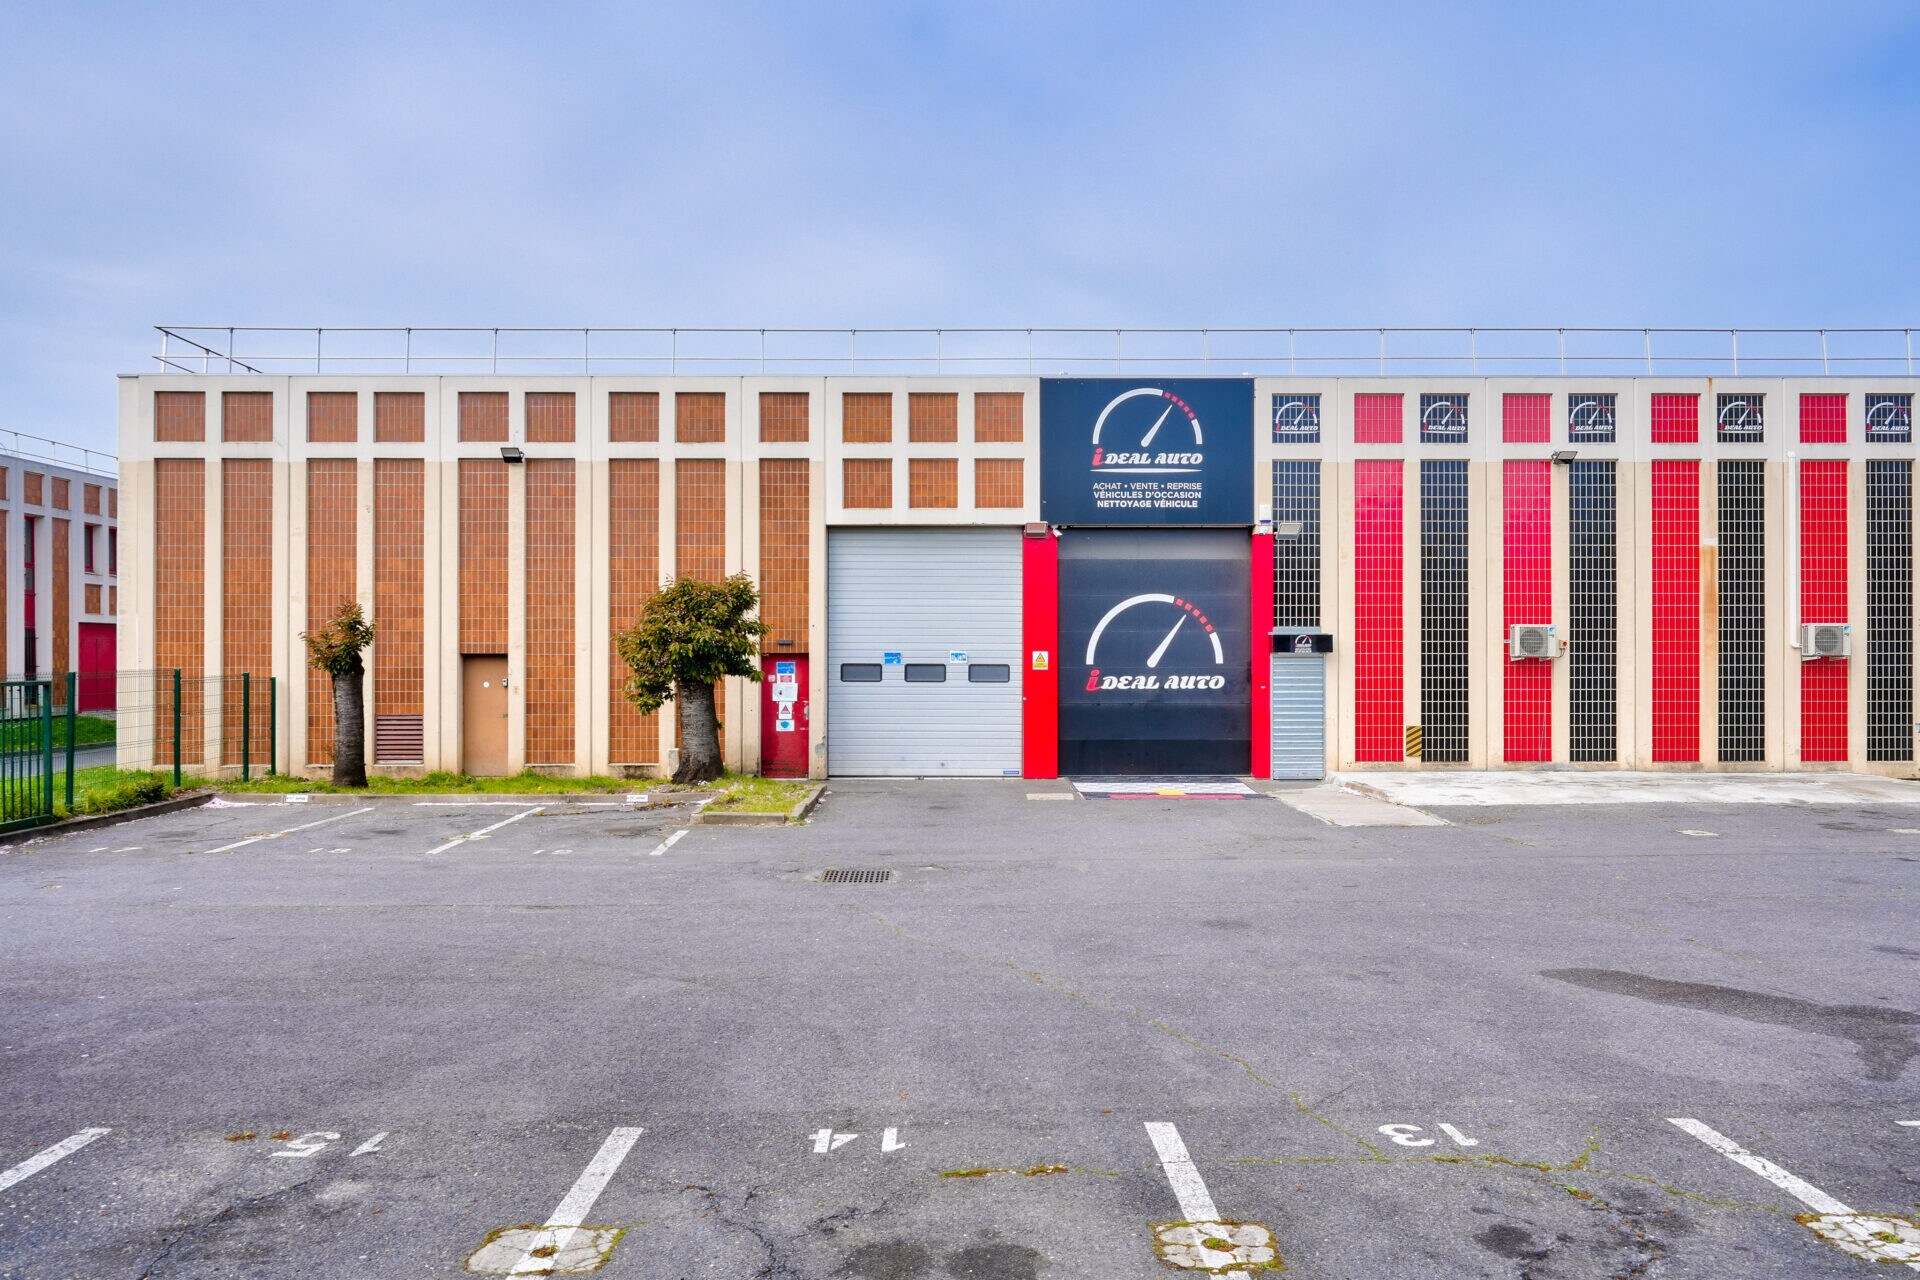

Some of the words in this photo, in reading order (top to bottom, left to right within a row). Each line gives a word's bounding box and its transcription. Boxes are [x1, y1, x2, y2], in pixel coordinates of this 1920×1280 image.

[1154, 453, 1203, 465] AUTO
[1092, 482, 1122, 490] ACHAT
[1130, 482, 1159, 490] VENTE
[1166, 482, 1203, 490] REPRISE
[1093, 489, 1143, 499] VÉHICULES
[1145, 491, 1202, 499] D'OCCASION
[1097, 500, 1152, 508] NETTOYAGE
[1154, 498, 1199, 508] VÉHICULE
[1163, 675, 1226, 690] AUTO
[808, 1127, 906, 1153] 14
[1378, 1122, 1479, 1147] 13
